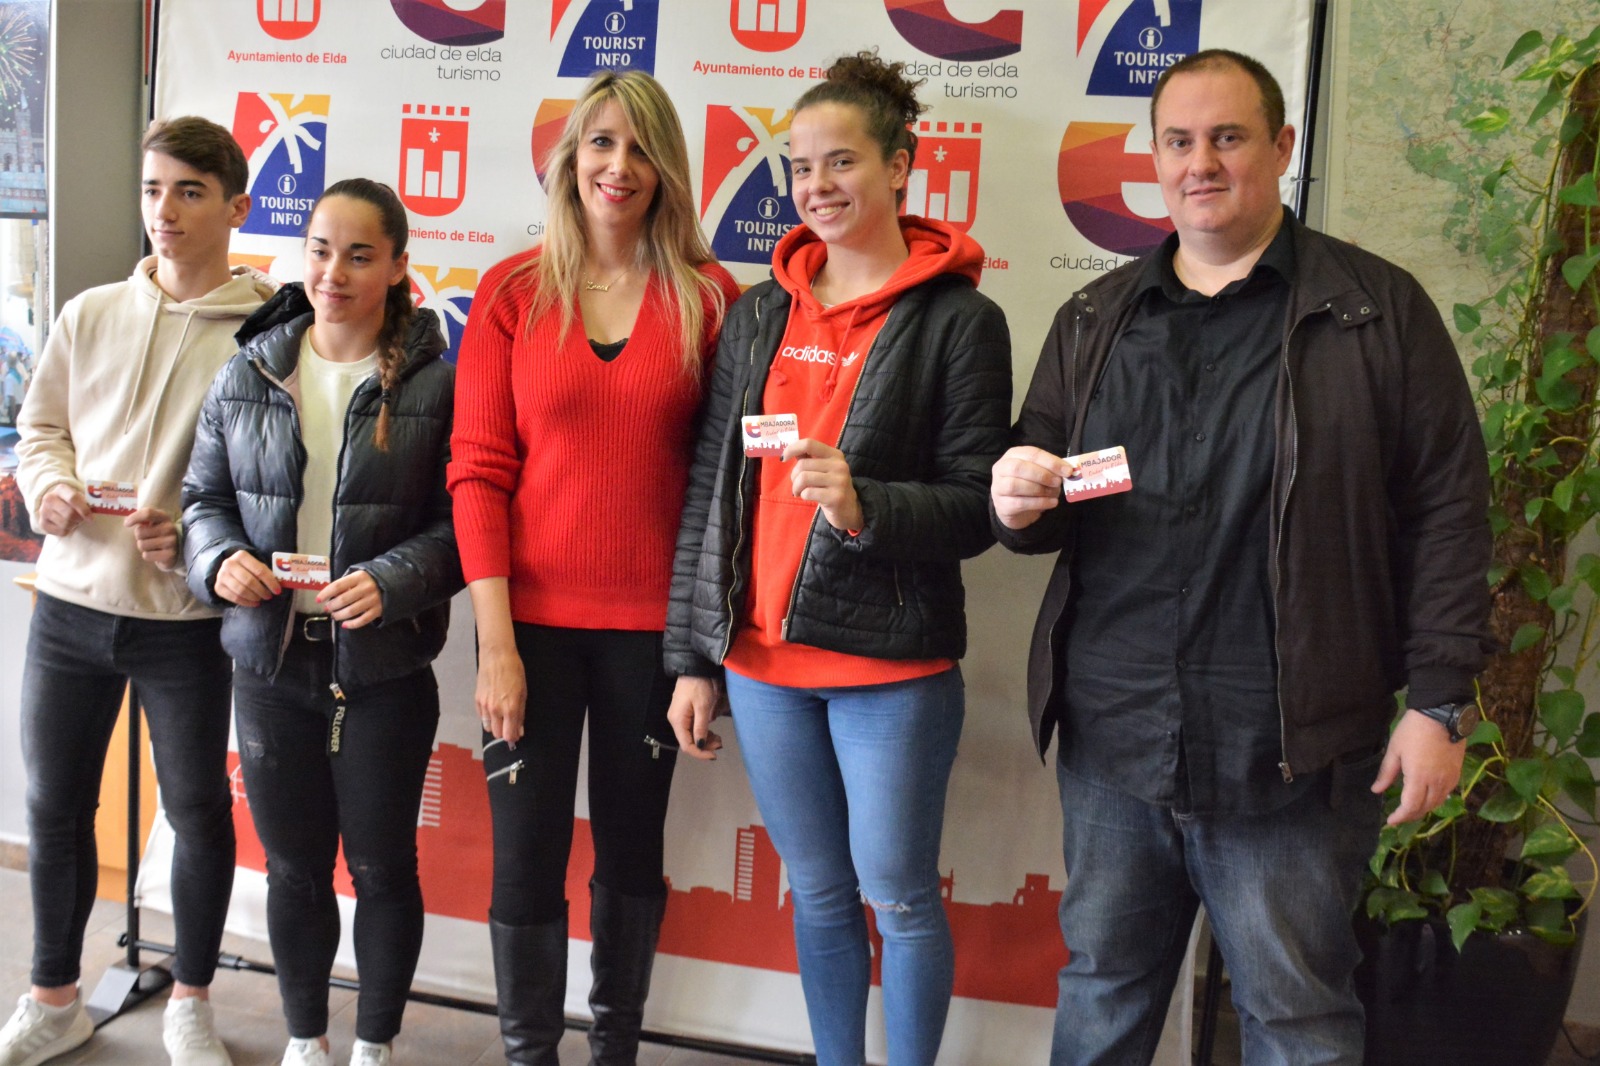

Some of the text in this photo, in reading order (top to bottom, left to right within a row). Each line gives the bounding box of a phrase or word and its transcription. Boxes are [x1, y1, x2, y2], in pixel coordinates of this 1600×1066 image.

[582, 36, 646, 50] TOURIST
[227, 50, 348, 64] Ayuntamiento de Elda
[380, 44, 502, 62] ciudad de elda
[595, 52, 631, 66] INFO
[1113, 51, 1187, 67] TOURIST
[437, 65, 501, 81] turismo
[692, 60, 785, 77] Ayuntamiento
[788, 66, 805, 78] de
[947, 60, 973, 78] de
[977, 62, 1019, 78] elda
[944, 82, 1018, 99] turismo
[259, 195, 315, 211] TOURIST
[271, 211, 303, 226] INFO
[408, 227, 495, 244] miento de Elda
[747, 237, 779, 252] INF
[1050, 253, 1118, 272] ciudad
[781, 345, 837, 367] adidas
